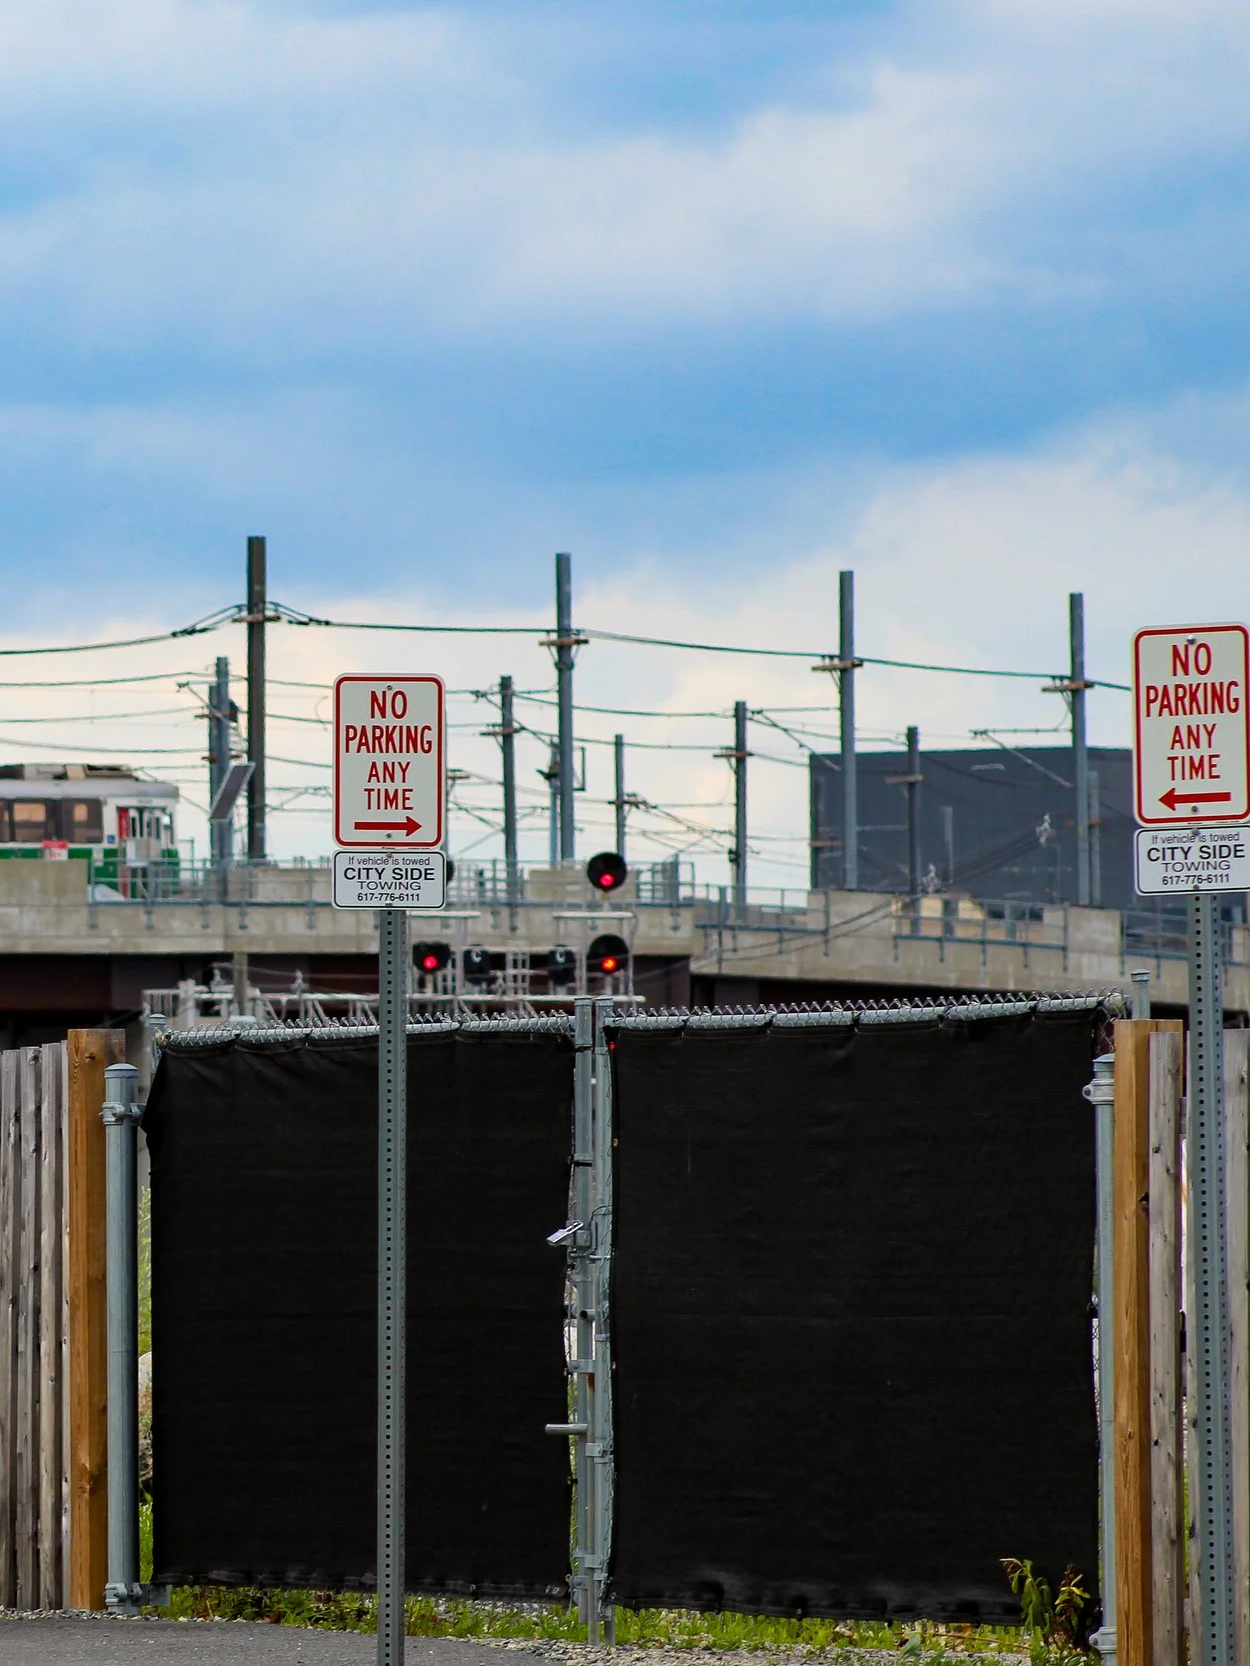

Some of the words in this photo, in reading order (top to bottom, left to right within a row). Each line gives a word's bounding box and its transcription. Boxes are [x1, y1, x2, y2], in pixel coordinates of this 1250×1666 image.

[1172, 642, 1212, 677] NO
[370, 690, 408, 720] NO
[1145, 680, 1240, 718] PARKING
[345, 724, 433, 754] PARKING
[1170, 723, 1217, 750] ANY
[367, 761, 411, 784] ANY
[1167, 753, 1221, 781] TIME
[364, 788, 413, 811] TIME
[1151, 834, 1158, 844] If
[1161, 833, 1195, 844] vehicle
[1199, 834, 1207, 843] is
[1210, 832, 1240, 842] towed
[348, 855, 355, 865] If
[357, 856, 389, 865] vehicle
[392, 857, 400, 865] is
[402, 856, 430, 865] towed
[1147, 846, 1192, 862] CITY
[1199, 844, 1245, 860] SIDE
[343, 867, 386, 880] CITY
[392, 867, 435, 881] SIDE
[1162, 860, 1231, 873] TOWING
[357, 881, 421, 890] TOWING
[1162, 873, 1230, 886] 617-776-6111
[357, 892, 420, 902] 617-776-6111
